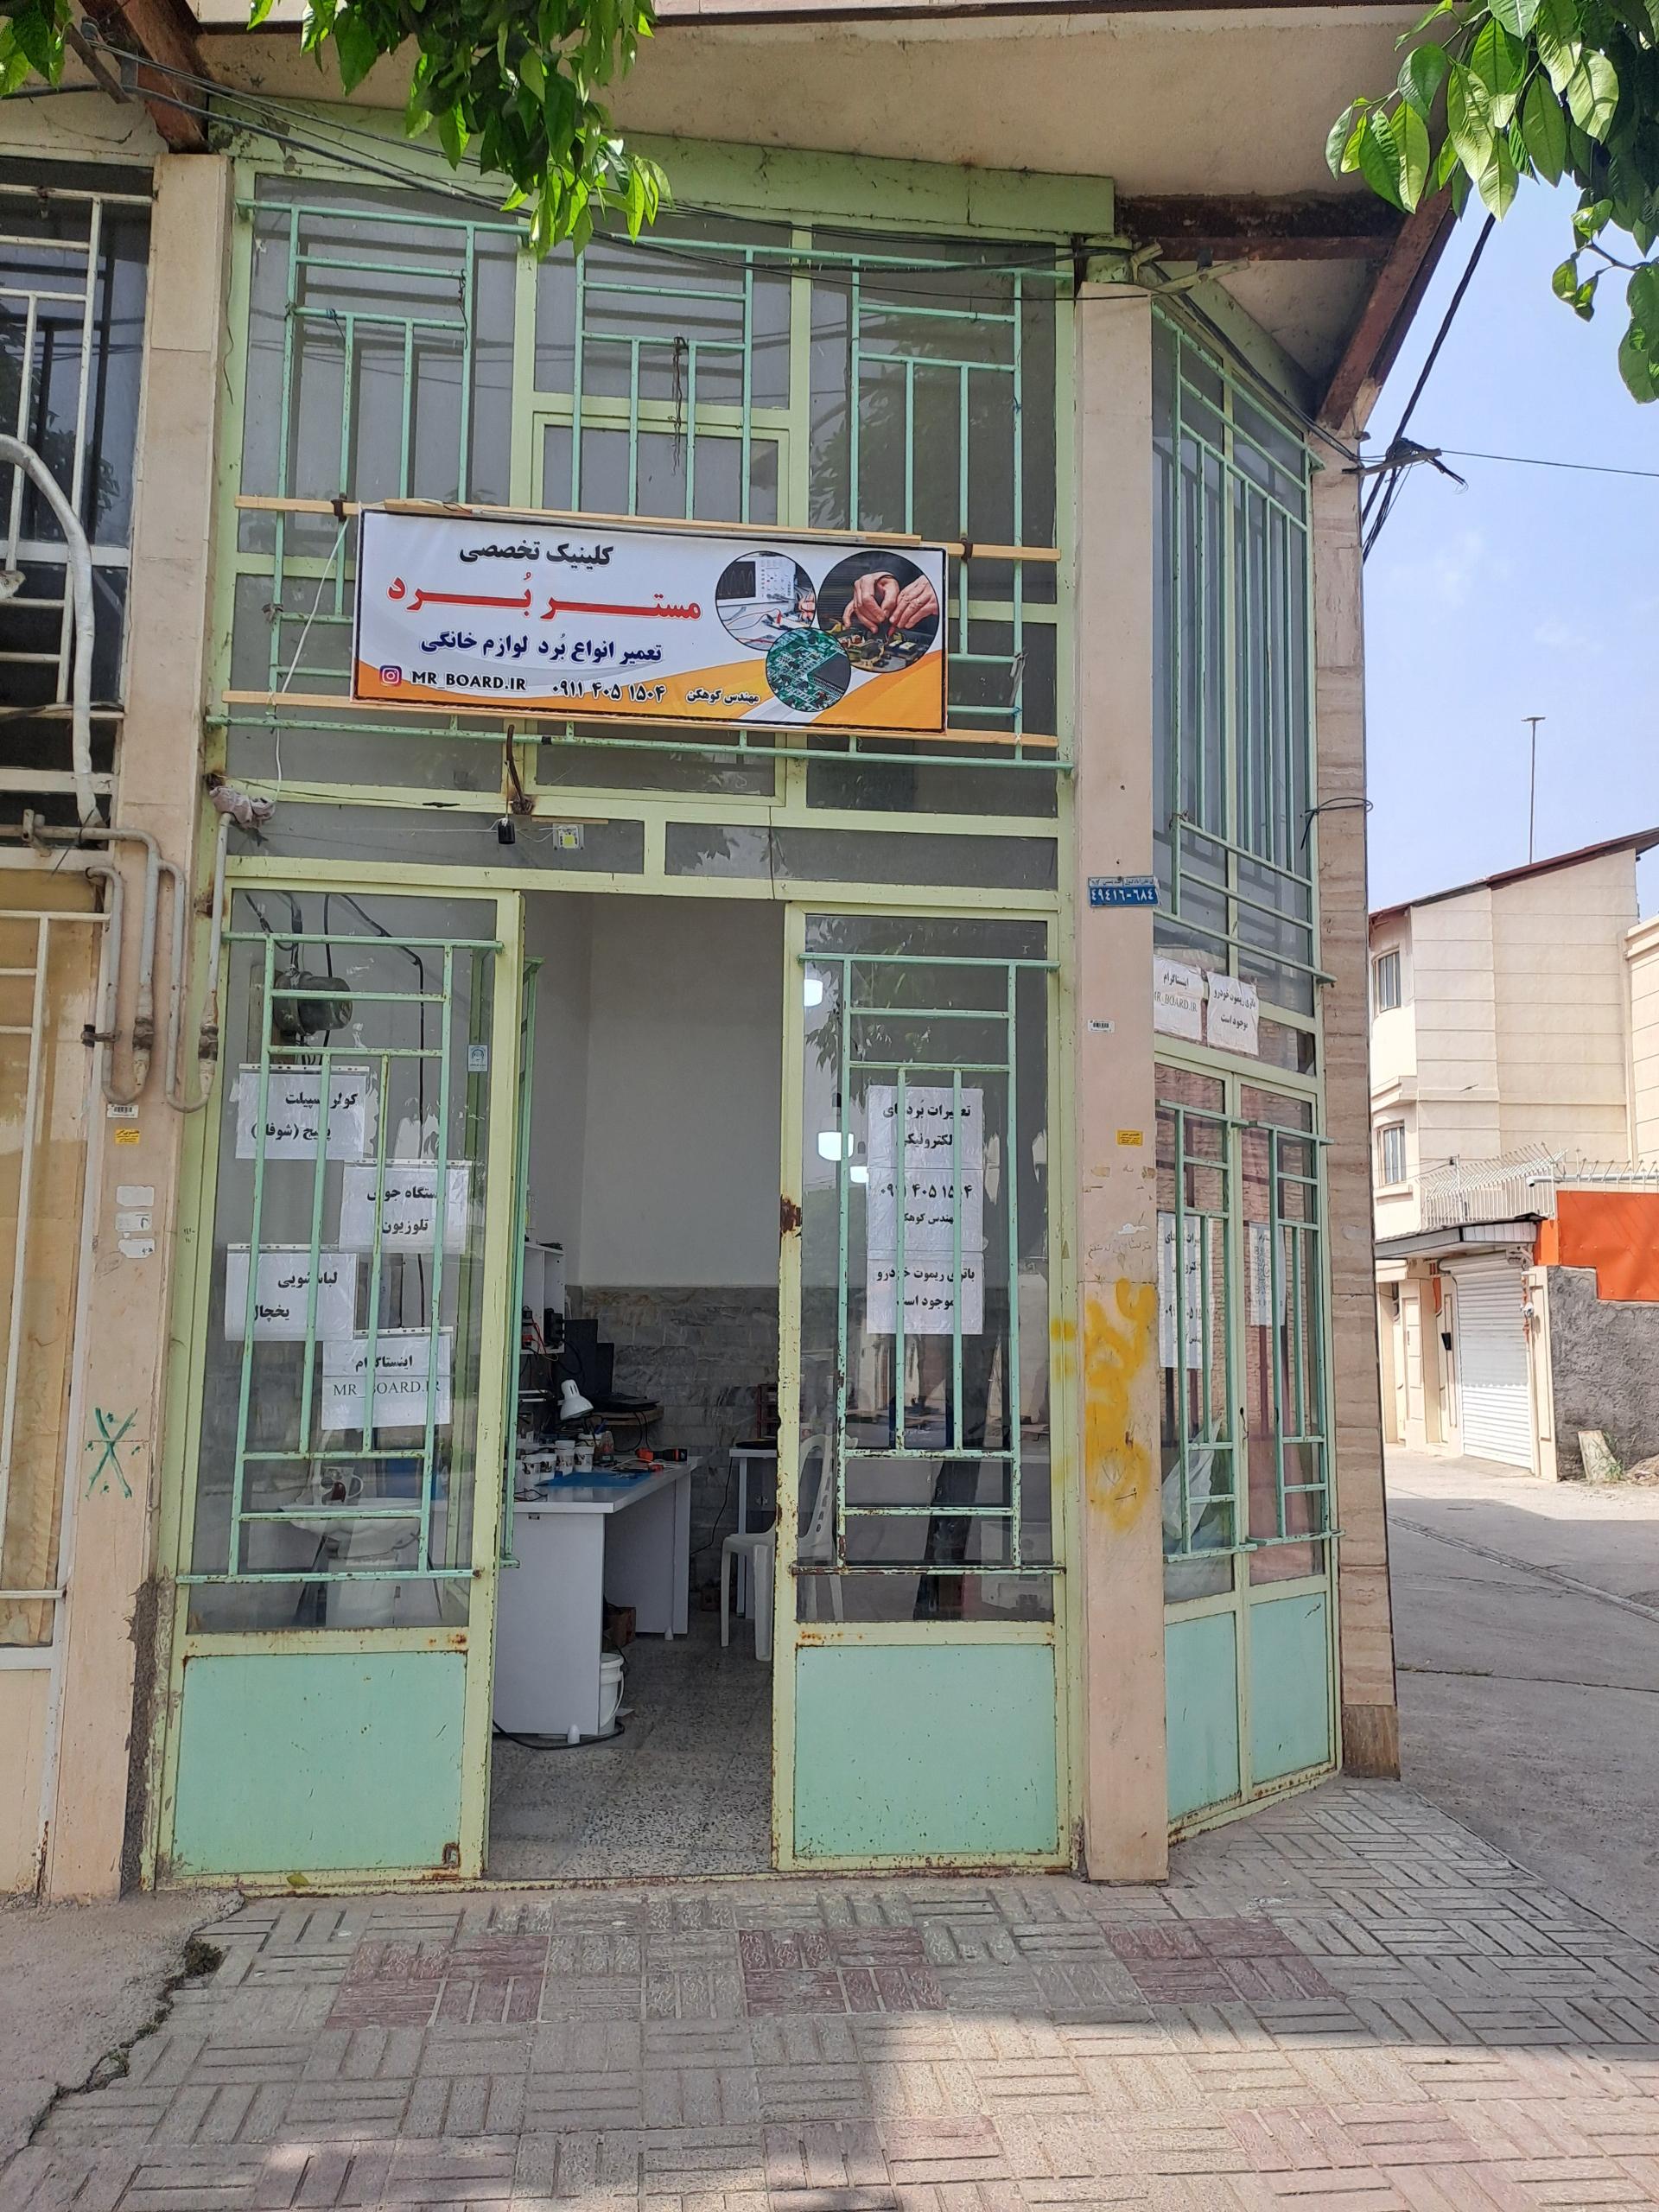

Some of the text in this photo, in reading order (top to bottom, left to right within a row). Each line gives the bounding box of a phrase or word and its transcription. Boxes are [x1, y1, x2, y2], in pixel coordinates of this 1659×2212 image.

[460, 540, 613, 569] کلینیک تخصصی
[541, 593, 702, 620] مستر
[421, 631, 478, 652] خانگی
[483, 635, 529, 658] لوازم
[571, 639, 614, 663] انواع
[620, 645, 662, 664] تعمیر
[411, 671, 526, 690] MR_BOARD.IR
[687, 688, 760, 704] مهندس کوهکن
[329, 1092, 359, 1109] کولر
[927, 1104, 971, 1120] تعیرات
[251, 1123, 332, 1141] پیج (شوفا)
[896, 1133, 953, 1148] لکترونیک
[404, 1186, 438, 1198] ستگاه
[880, 1183, 906, 1198] ۰۹۱
[942, 1185, 973, 1198] ۱۵۴
[904, 1213, 954, 1225] هندس کوهک
[876, 1267, 976, 1282] باتی ریموت خدرو
[896, 1295, 919, 1306] اس
[355, 1355, 413, 1372] اینستاگام
[334, 1380, 442, 1399] MR_OARD.IR
